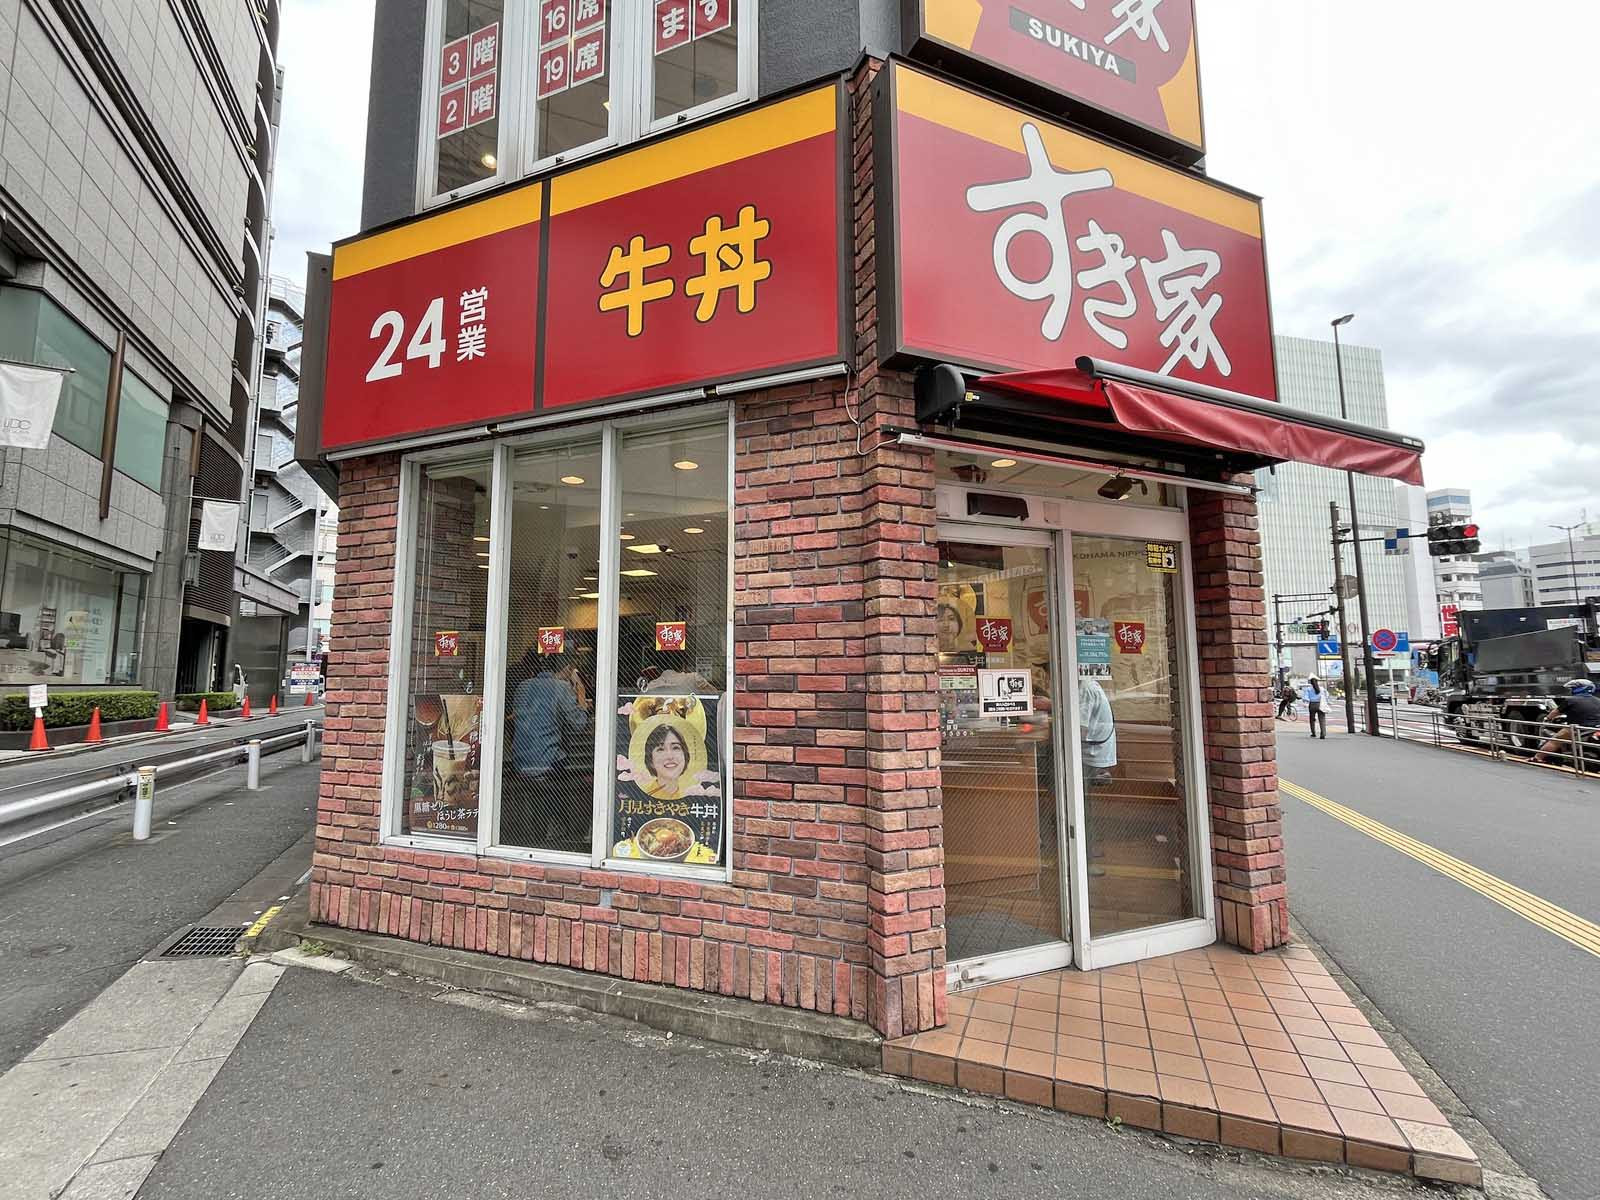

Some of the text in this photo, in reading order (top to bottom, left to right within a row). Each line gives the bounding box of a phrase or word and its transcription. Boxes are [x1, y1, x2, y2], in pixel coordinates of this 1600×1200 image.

[661, 0, 718, 39] ます
[448, 35, 496, 75] 3階
[543, 40, 600, 84] 19席
[1028, 18, 1120, 75] SUKIYA
[446, 84, 494, 124] 2階
[966, 122, 1233, 377] すき家
[598, 203, 772, 337] 牛丼
[365, 297, 447, 383] 24
[456, 285, 489, 361] 営業
[660, 625, 683, 643] すき家
[981, 619, 1009, 643] すき家
[1118, 623, 1143, 645] すき家
[618, 799, 718, 819] 月見すきやき牛丼
